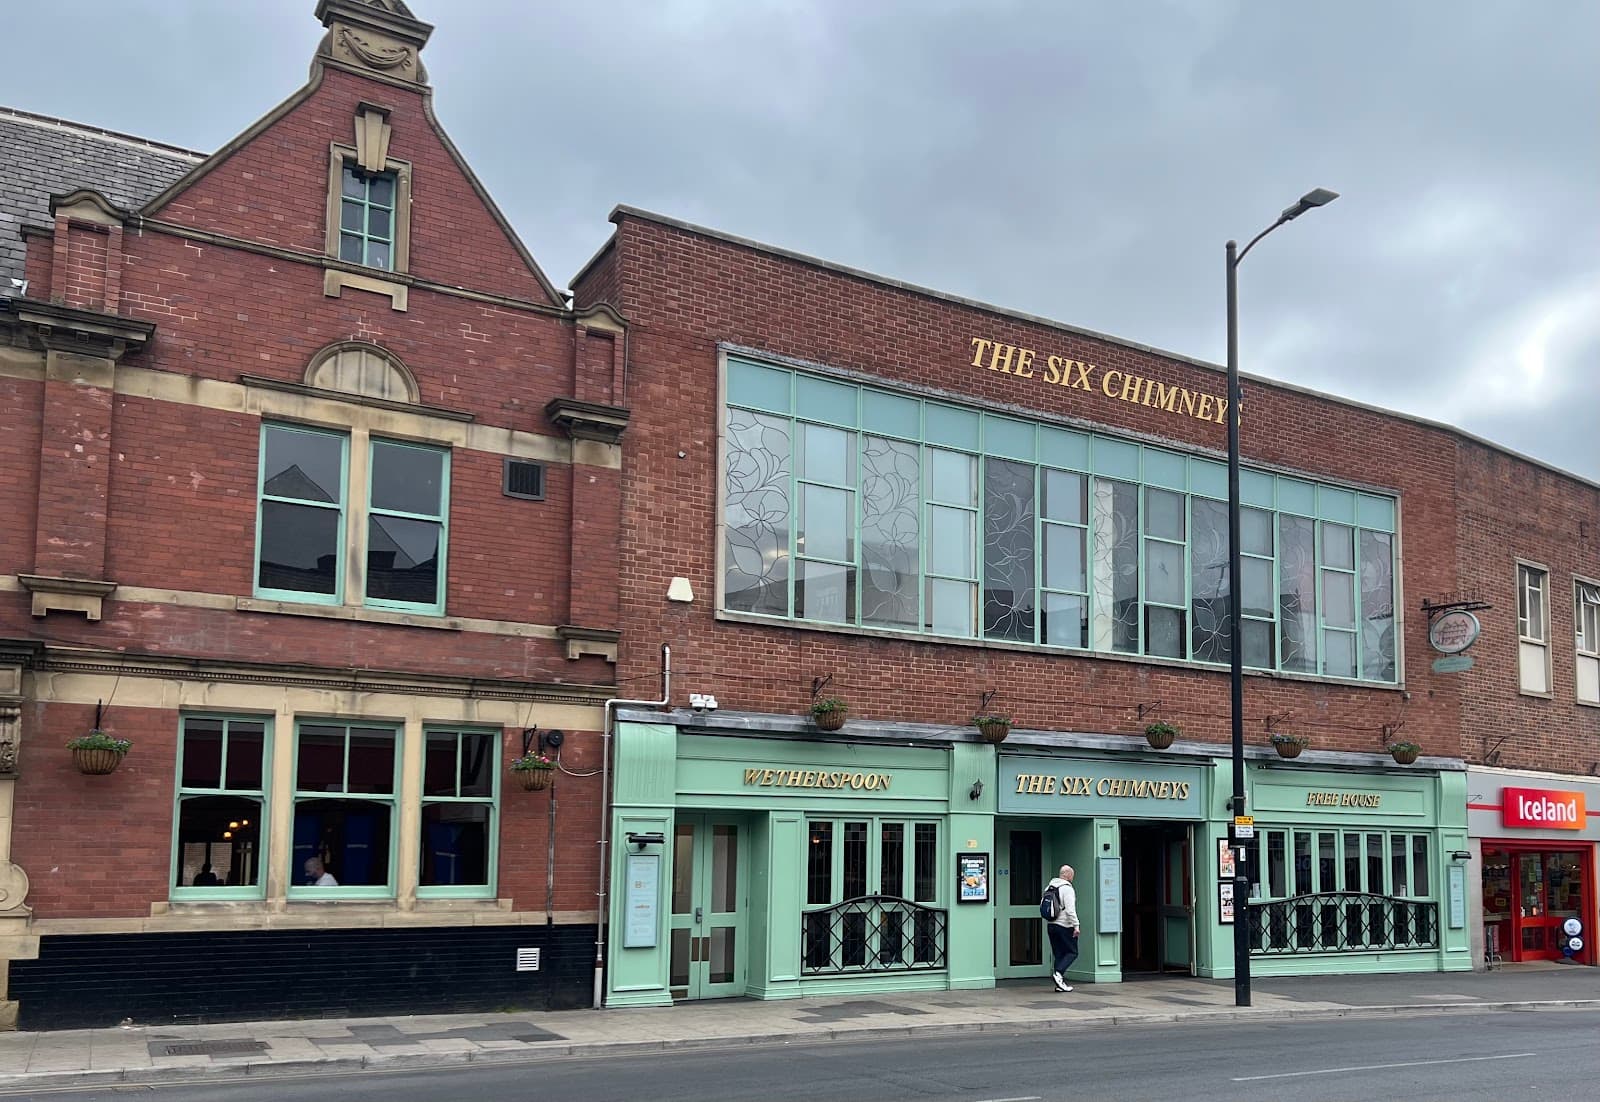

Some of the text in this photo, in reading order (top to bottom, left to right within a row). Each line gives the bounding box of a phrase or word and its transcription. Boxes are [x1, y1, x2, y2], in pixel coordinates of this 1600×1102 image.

[970, 337, 1036, 378] THE
[1043, 355, 1096, 391] SIX
[744, 768, 893, 791] WETHERSPOON
[1015, 774, 1190, 800] THE SIX CHIMNEYS
[1306, 792, 1381, 808] FREE HOUSE
[1518, 795, 1577, 822] Iceland
